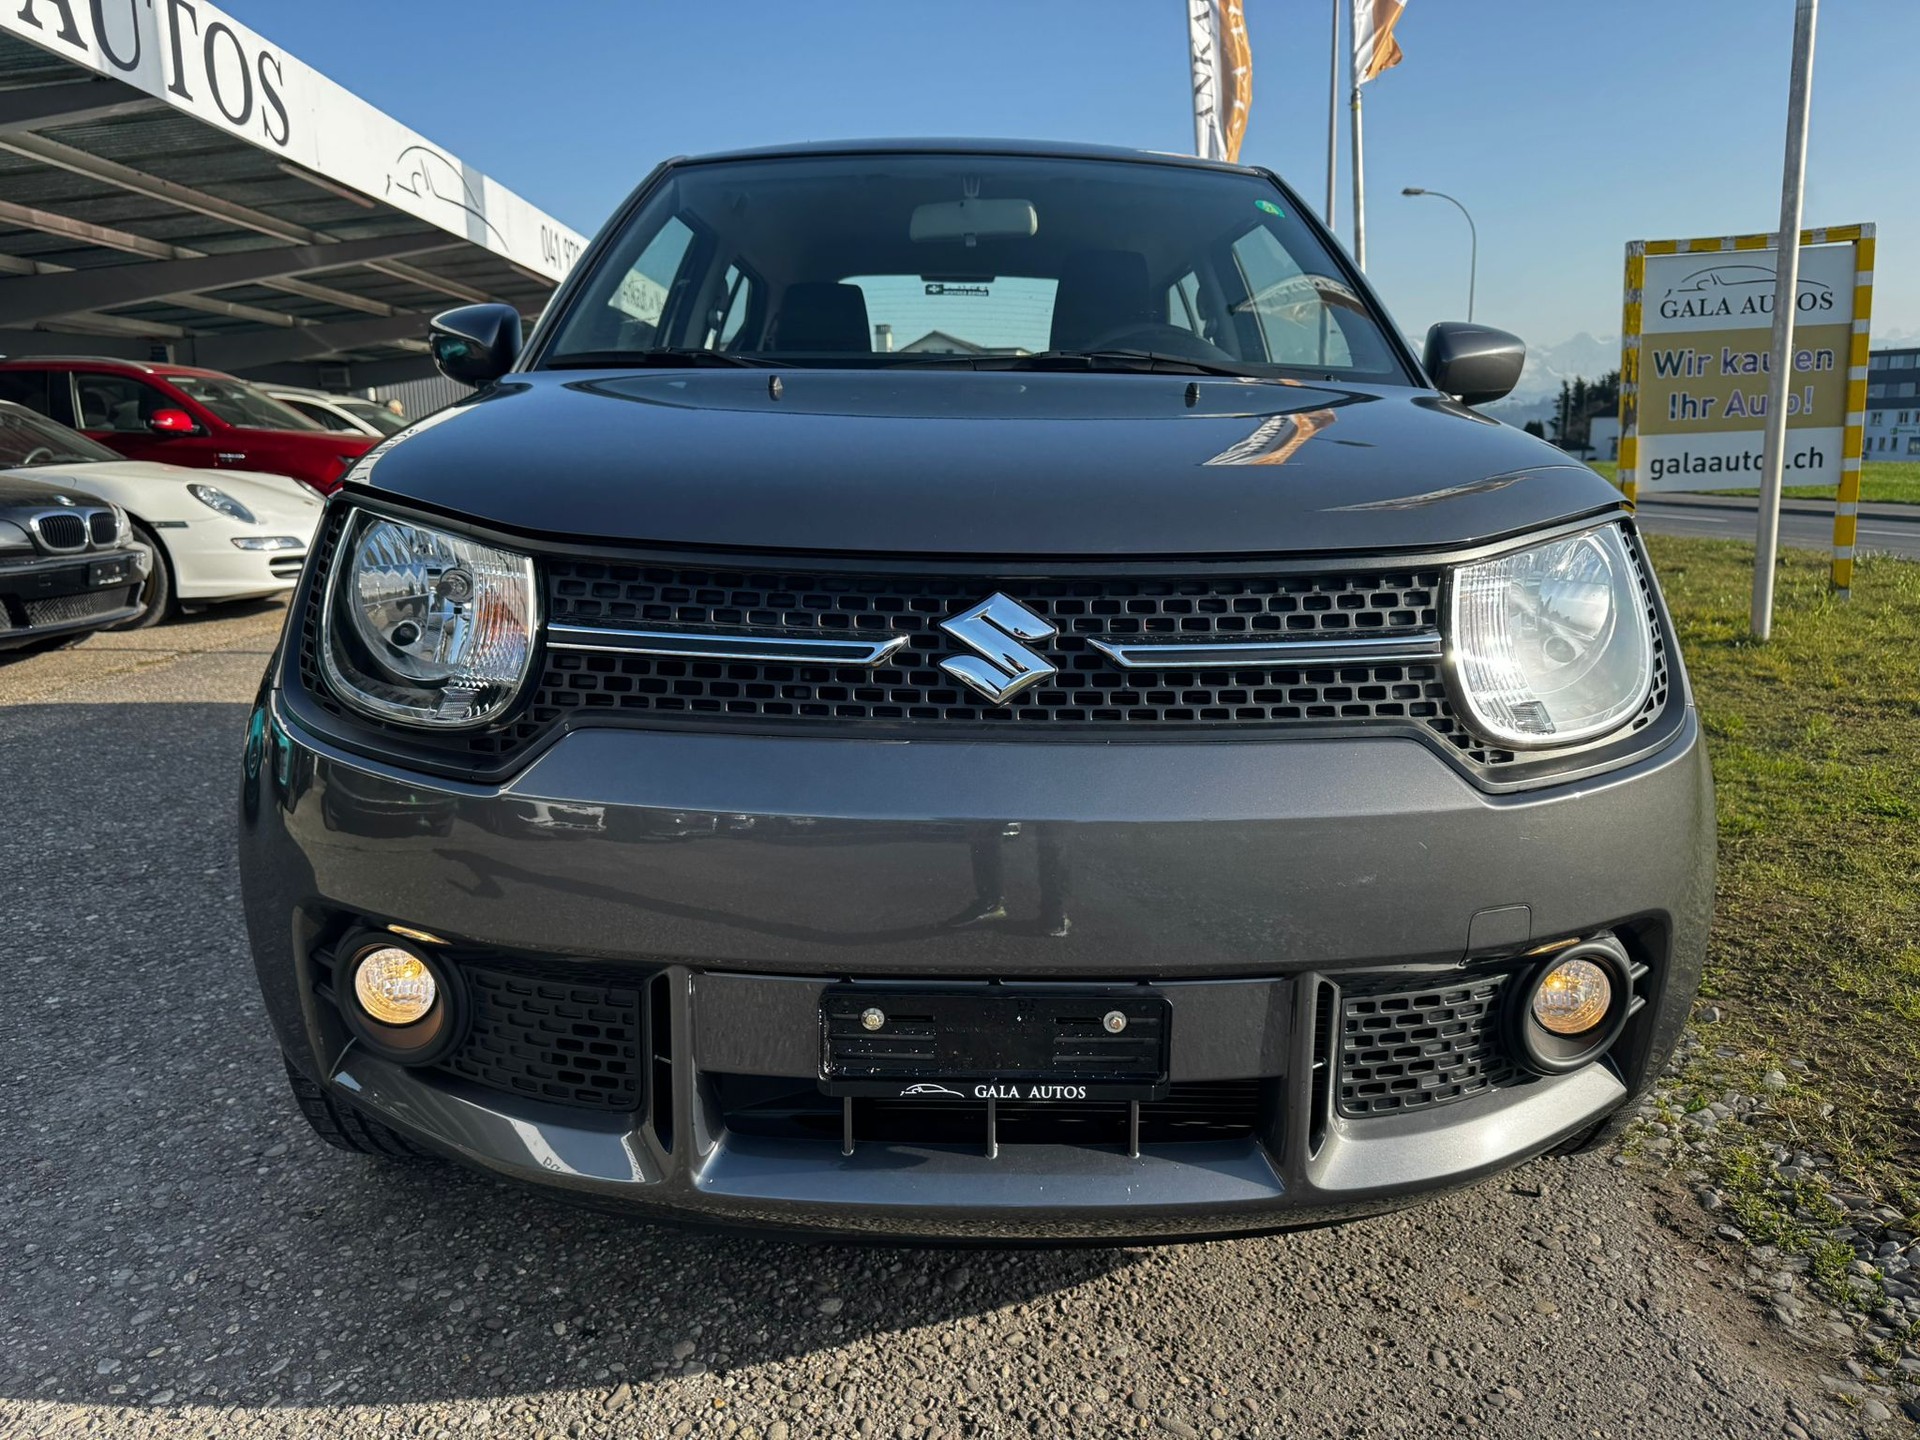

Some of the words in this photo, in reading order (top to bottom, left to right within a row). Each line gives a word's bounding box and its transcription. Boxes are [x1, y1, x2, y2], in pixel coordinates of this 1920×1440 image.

[1192, 0, 1216, 129] ANKA
[1659, 297, 1732, 319] GALA
[1740, 291, 1834, 315] AUOS
[1653, 349, 1712, 378] Wir
[1720, 344, 1834, 376] kaen
[1668, 391, 1717, 420] Ihr
[1722, 386, 1814, 419] Auo!
[1650, 446, 1824, 481] galaauto.ch
[974, 1084, 1020, 1099] GALA
[1028, 1085, 1087, 1099] AUTOS
